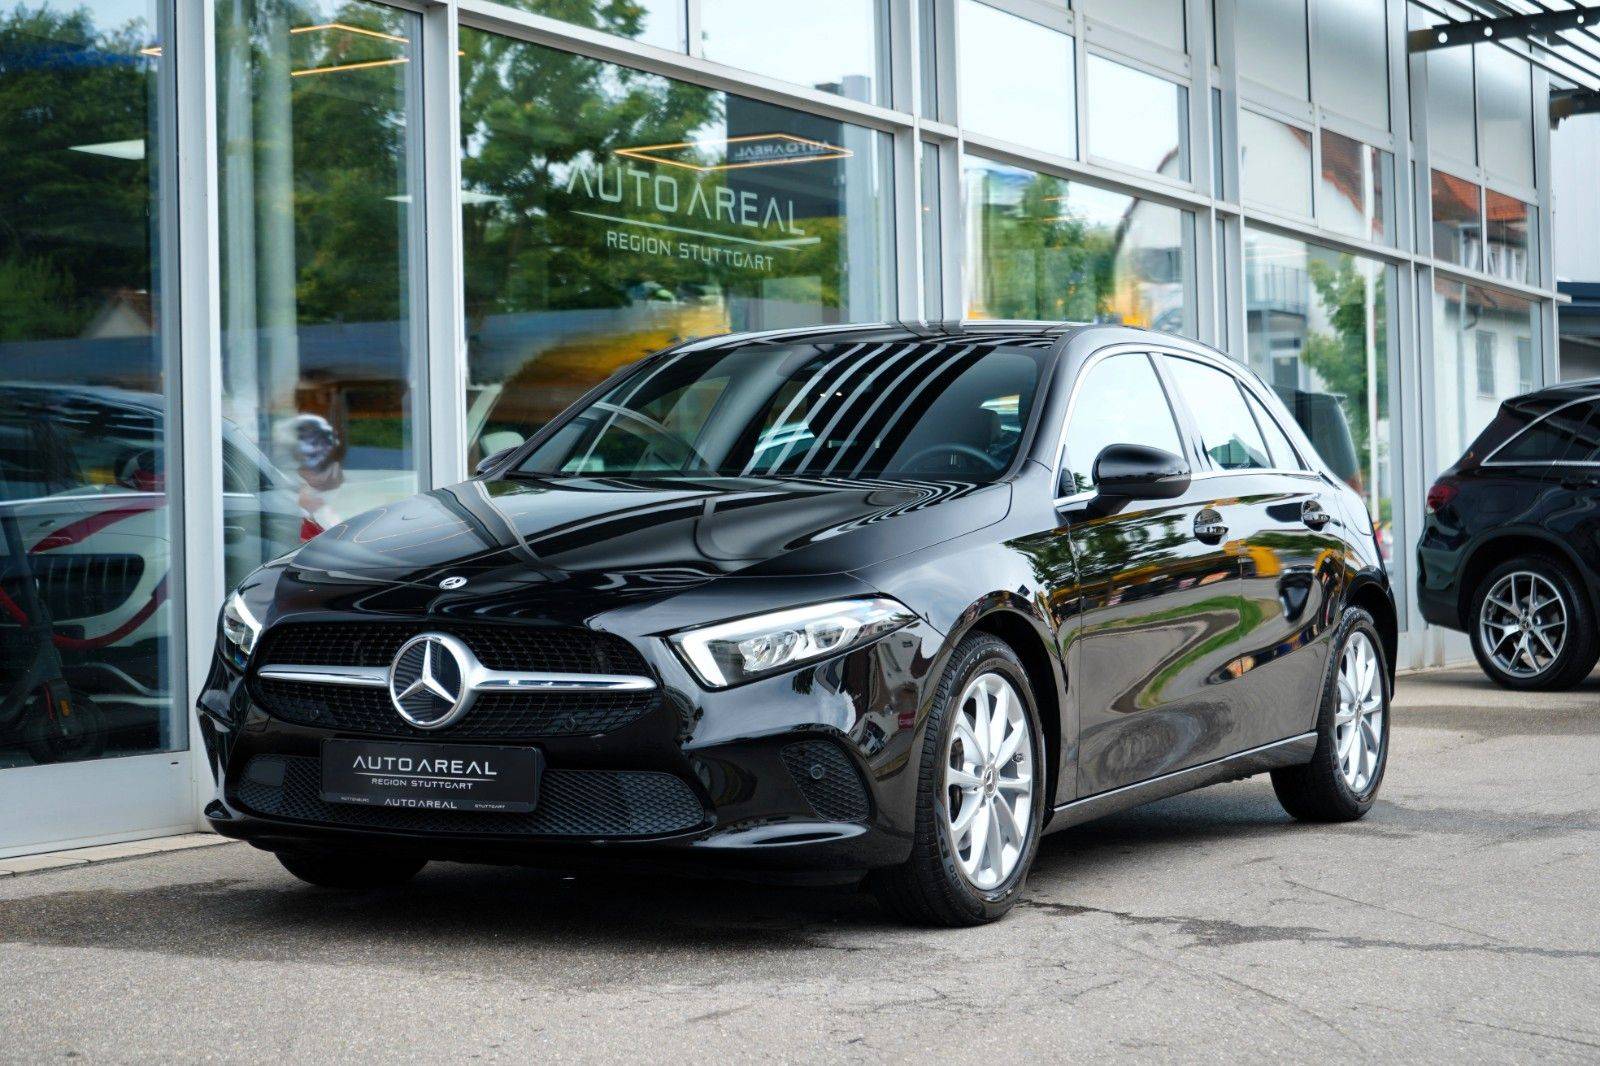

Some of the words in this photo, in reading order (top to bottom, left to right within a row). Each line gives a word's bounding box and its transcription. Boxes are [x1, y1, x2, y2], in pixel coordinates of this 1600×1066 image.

[606, 231, 672, 257] REGION
[679, 243, 774, 273] STUTTGART
[371, 778, 407, 787] REGION
[411, 780, 473, 790] STUTTGART
